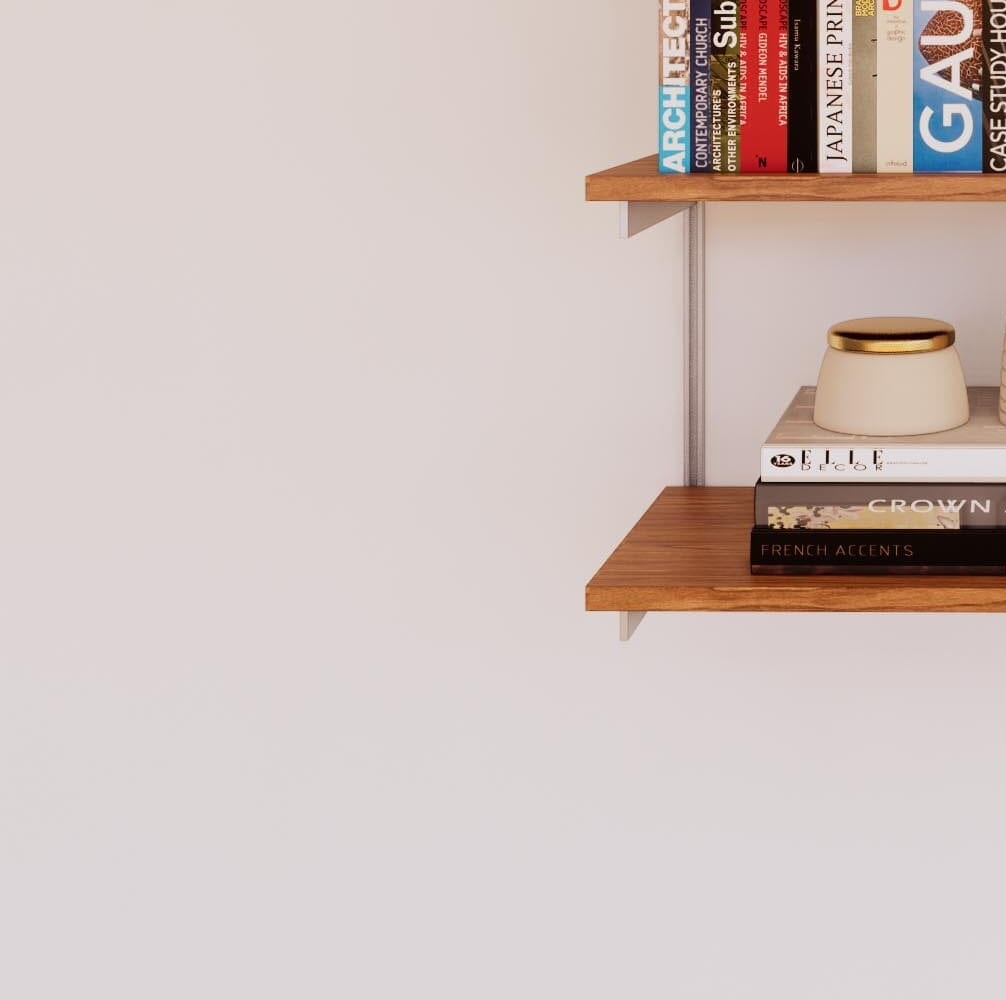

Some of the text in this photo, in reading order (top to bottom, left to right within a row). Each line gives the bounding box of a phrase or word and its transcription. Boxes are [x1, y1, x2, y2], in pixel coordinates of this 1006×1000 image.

[758, 33, 768, 66] GIDEON
[777, 33, 787, 49] HIV
[777, 60, 787, 81] AIDS
[793, 44, 801, 71] Kawara
[695, 18, 708, 168] CONTEMPORARY CHURCH
[758, 68, 768, 103] MENDEL
[777, 82, 787, 93] IN
[727, 61, 737, 172] OTHER ENVIRONMENTS
[777, 95, 787, 126] AFRICA
[826, 48, 848, 162] JAPANESE
[712, 89, 722, 172] ARCHITECTURE'S
[801, 449, 884, 465] ELLE
[867, 499, 990, 513] CROWN
[761, 544, 914, 557] FRENCH ACCENTS
